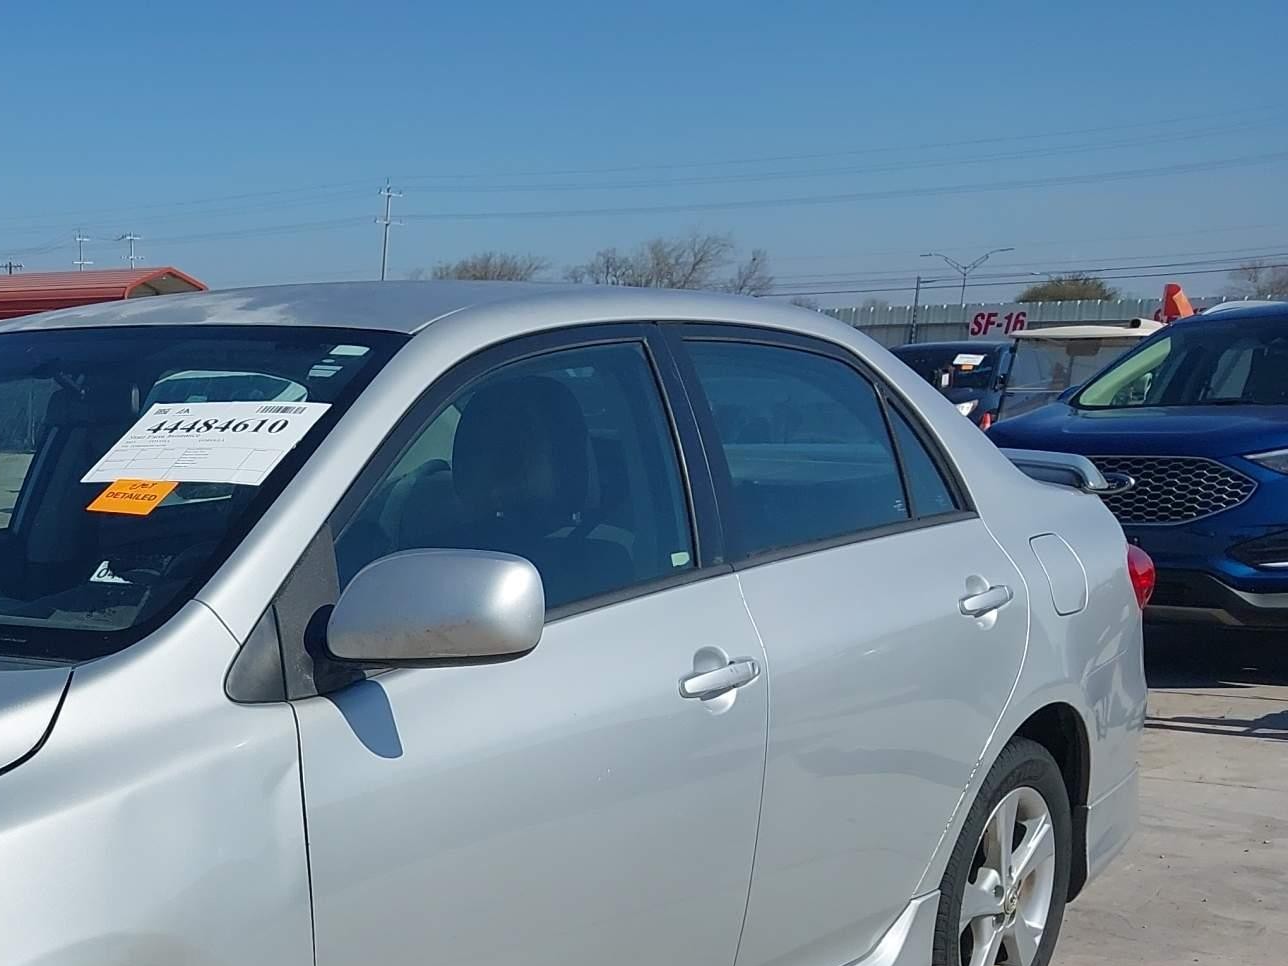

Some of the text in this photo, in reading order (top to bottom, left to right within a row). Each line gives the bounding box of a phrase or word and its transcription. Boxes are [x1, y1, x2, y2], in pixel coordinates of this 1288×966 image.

[969, 311, 1027, 336] SF-16
[146, 418, 289, 434] 44484610
[105, 491, 157, 502] DETAILED
